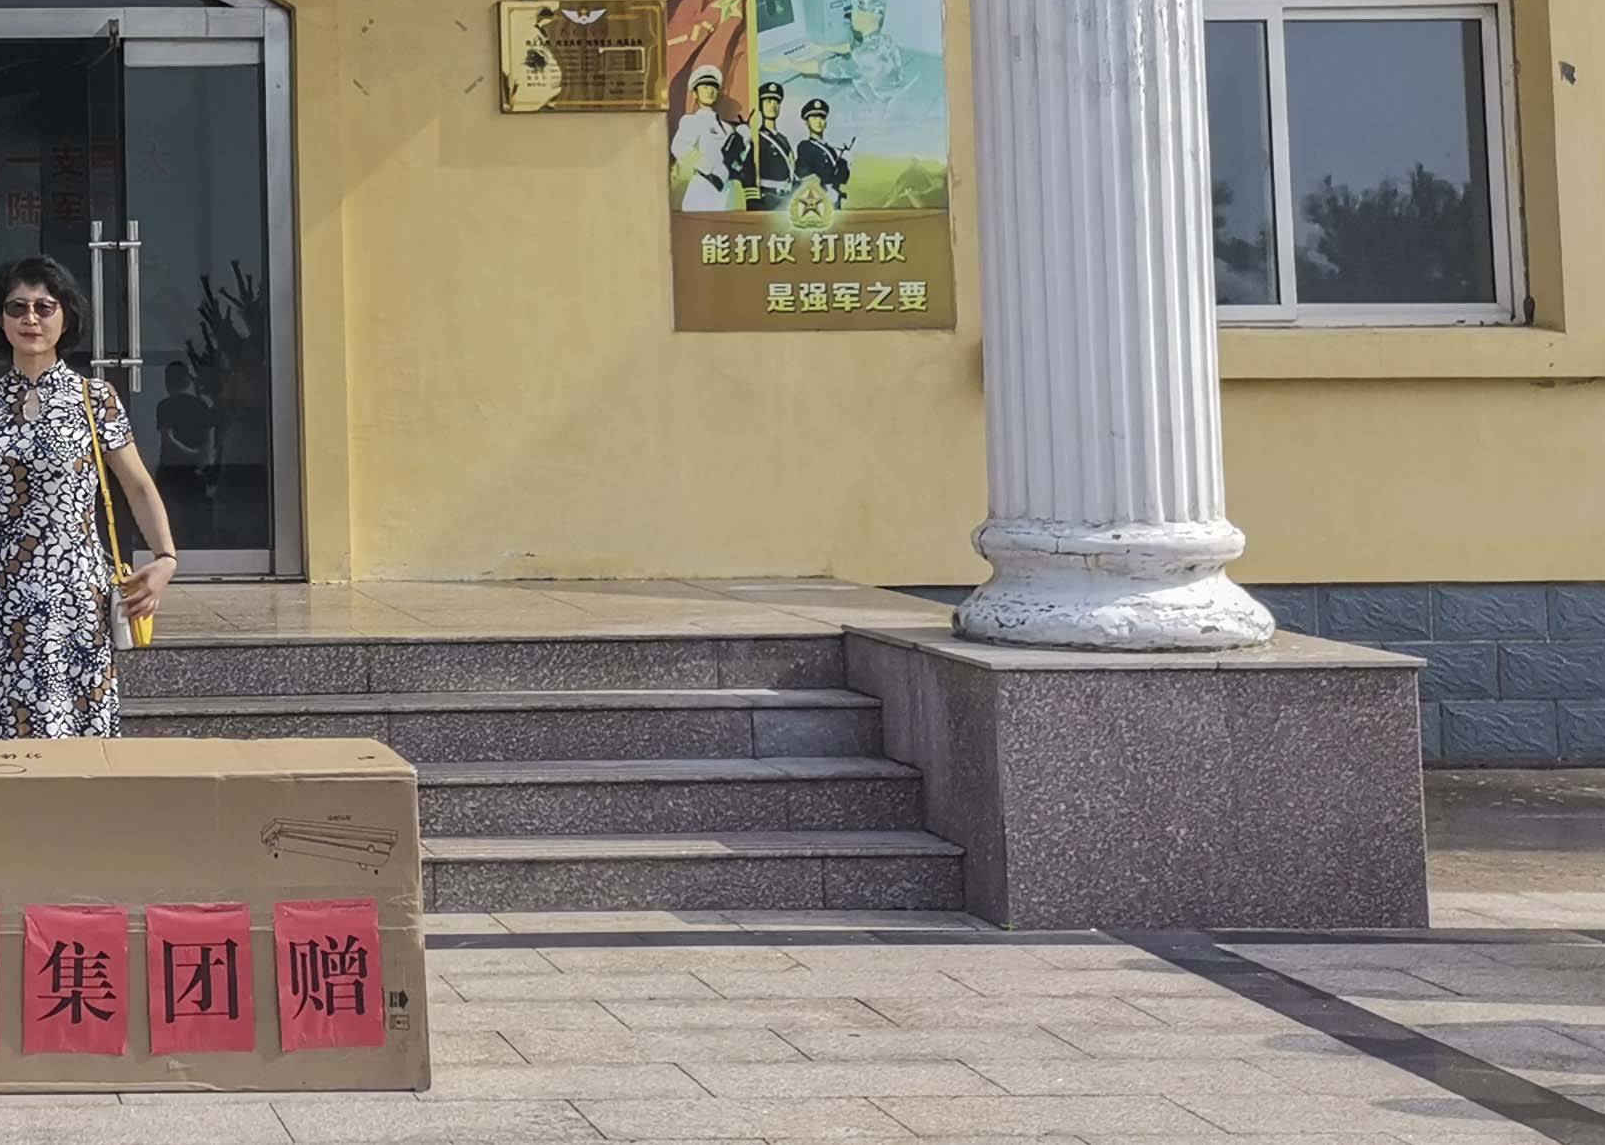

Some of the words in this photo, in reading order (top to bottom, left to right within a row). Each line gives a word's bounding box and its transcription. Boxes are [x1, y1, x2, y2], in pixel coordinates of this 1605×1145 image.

[701, 233, 796, 265] 能打仗
[810, 230, 906, 264] 打胜仗
[766, 279, 928, 313] 是强军之要
